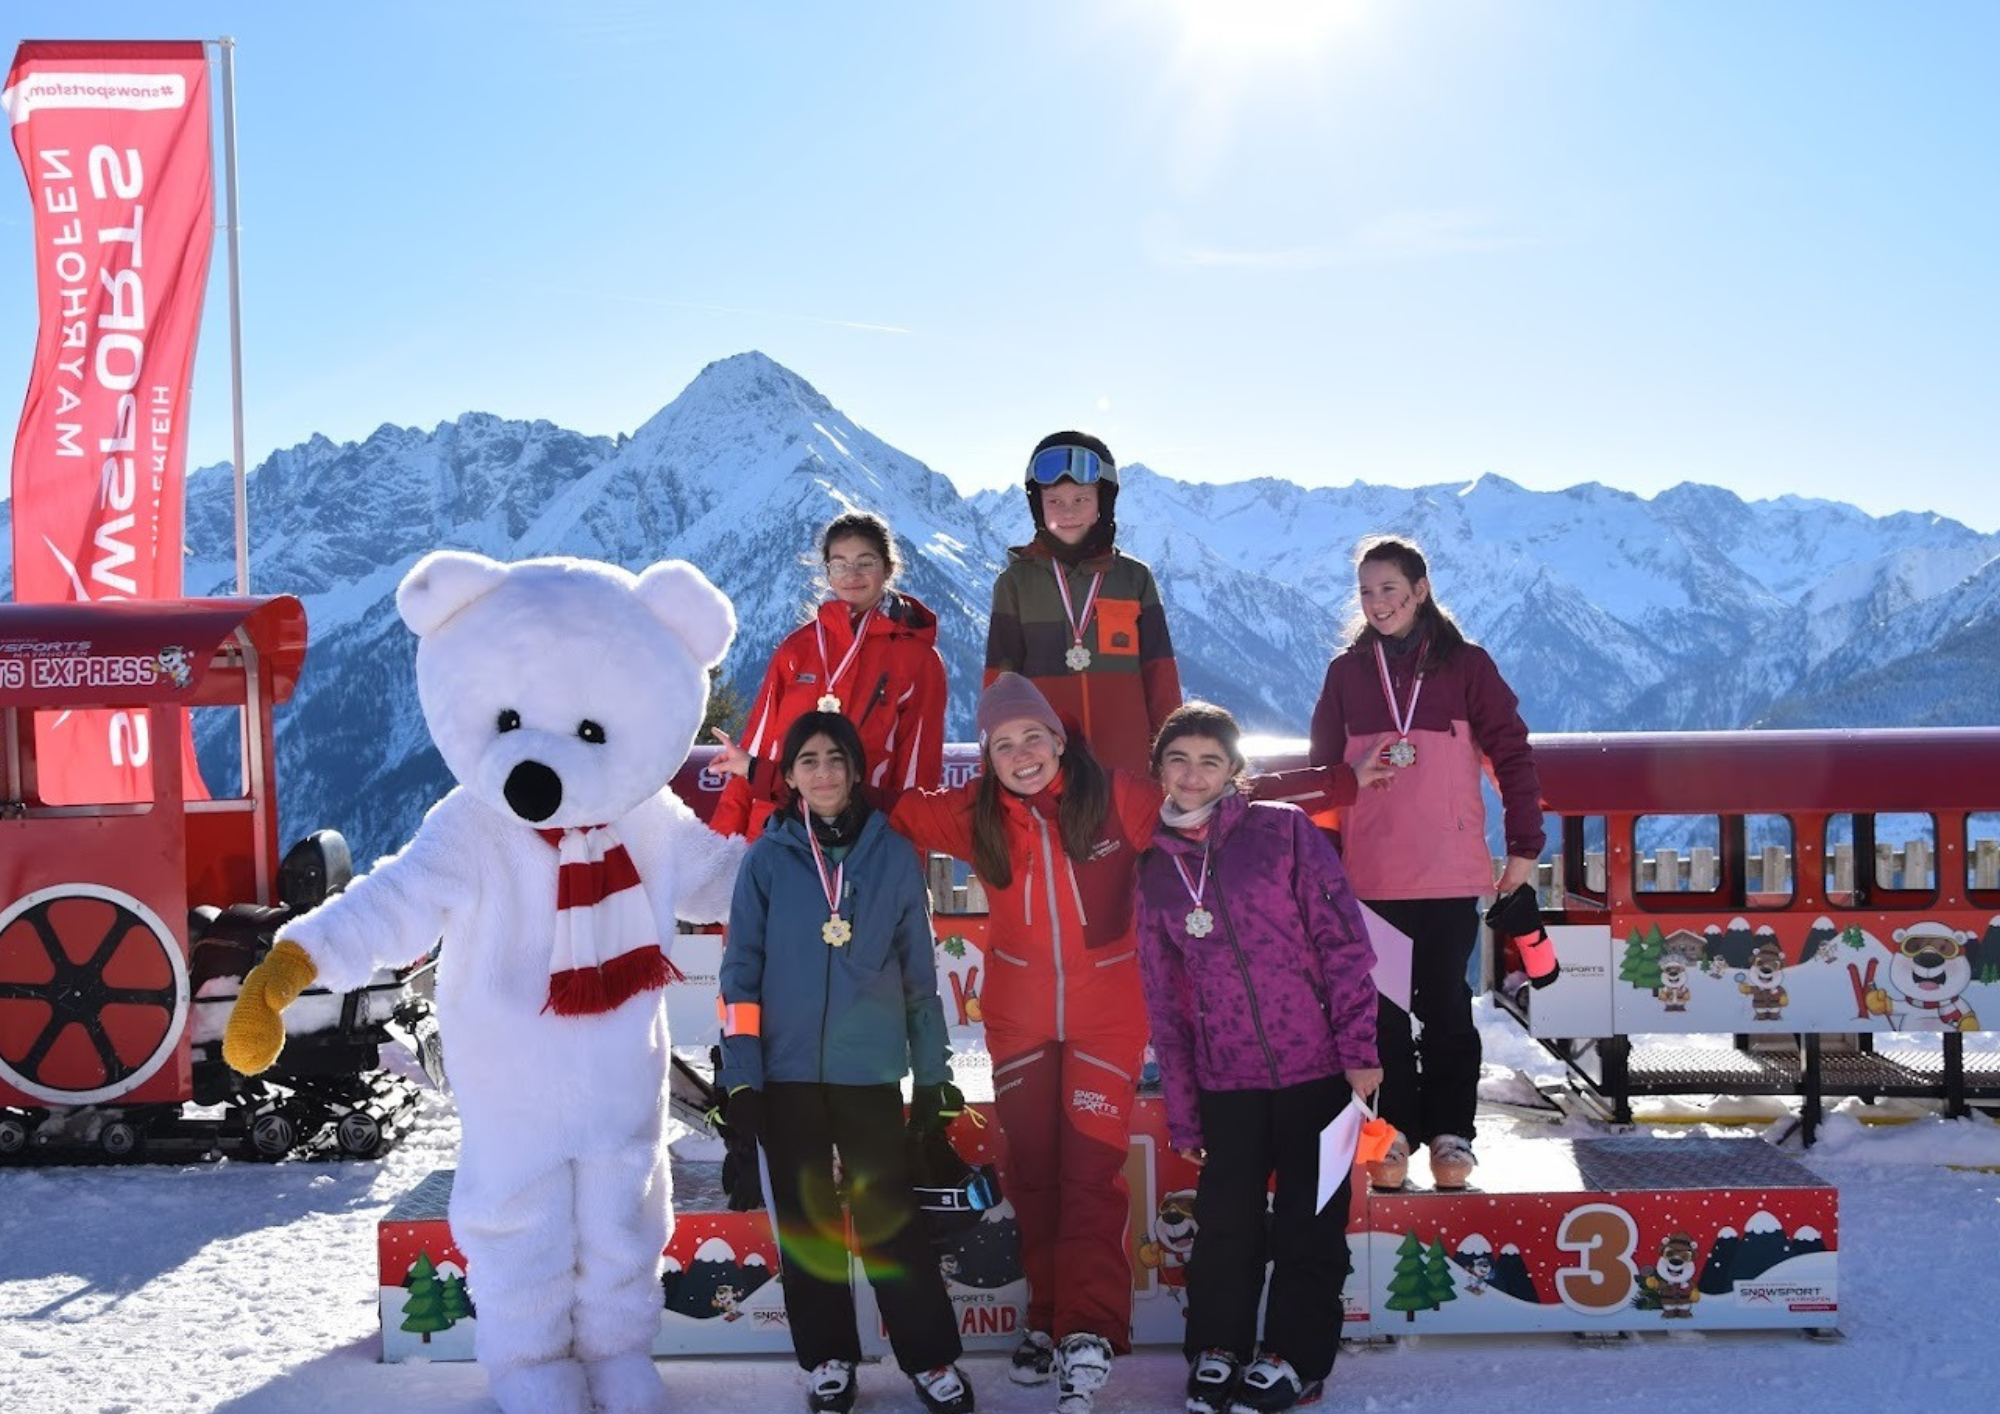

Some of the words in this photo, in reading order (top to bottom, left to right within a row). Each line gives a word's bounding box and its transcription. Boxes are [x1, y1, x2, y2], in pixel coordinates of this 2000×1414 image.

[13, 650, 90, 659] MAYRHOFEN
[31, 656, 157, 687] EXPRESS
[1555, 1203, 1639, 1316] 3
[951, 1293, 996, 1303] PORTS
